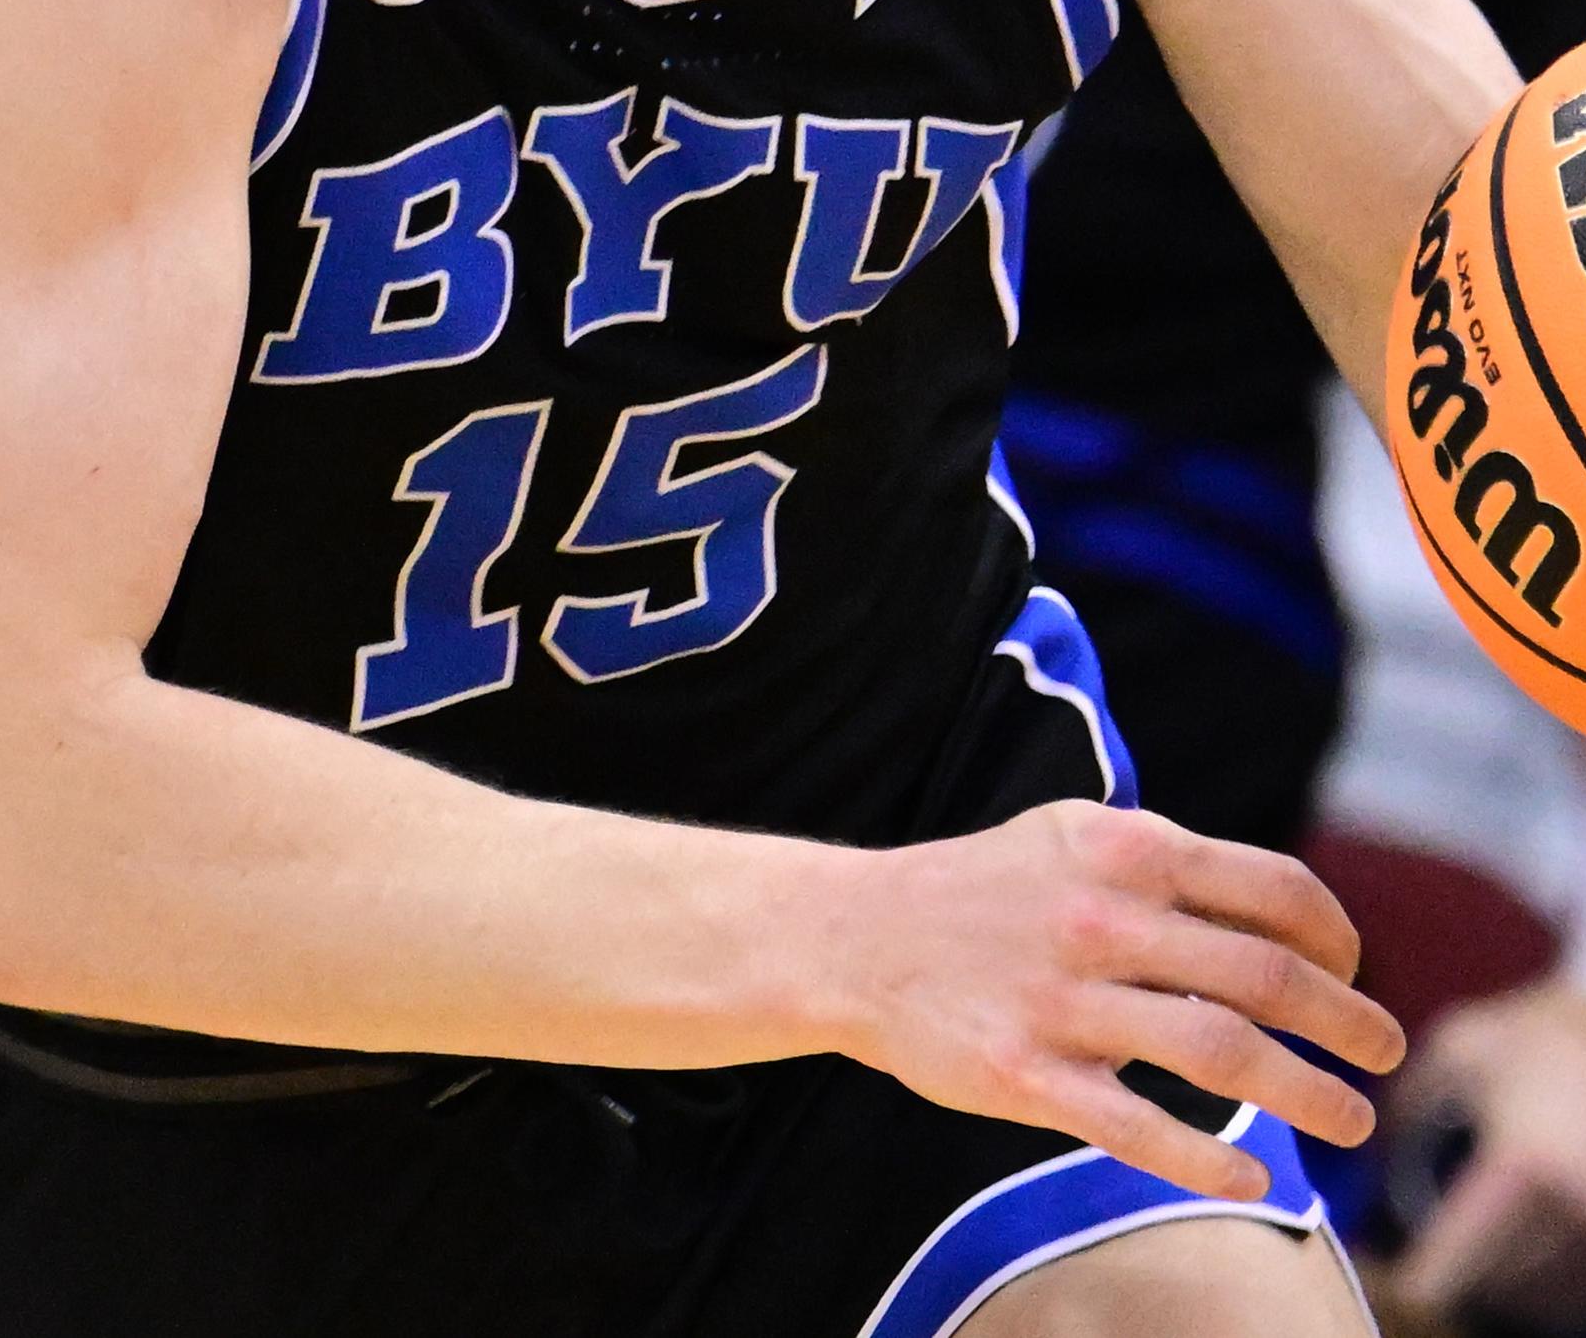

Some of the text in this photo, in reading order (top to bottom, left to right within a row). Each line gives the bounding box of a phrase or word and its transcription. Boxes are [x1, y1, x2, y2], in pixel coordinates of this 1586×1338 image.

[249, 88, 1024, 384] BYU
[1456, 249, 1502, 387] EVO NXT
[351, 342, 828, 734] 15
